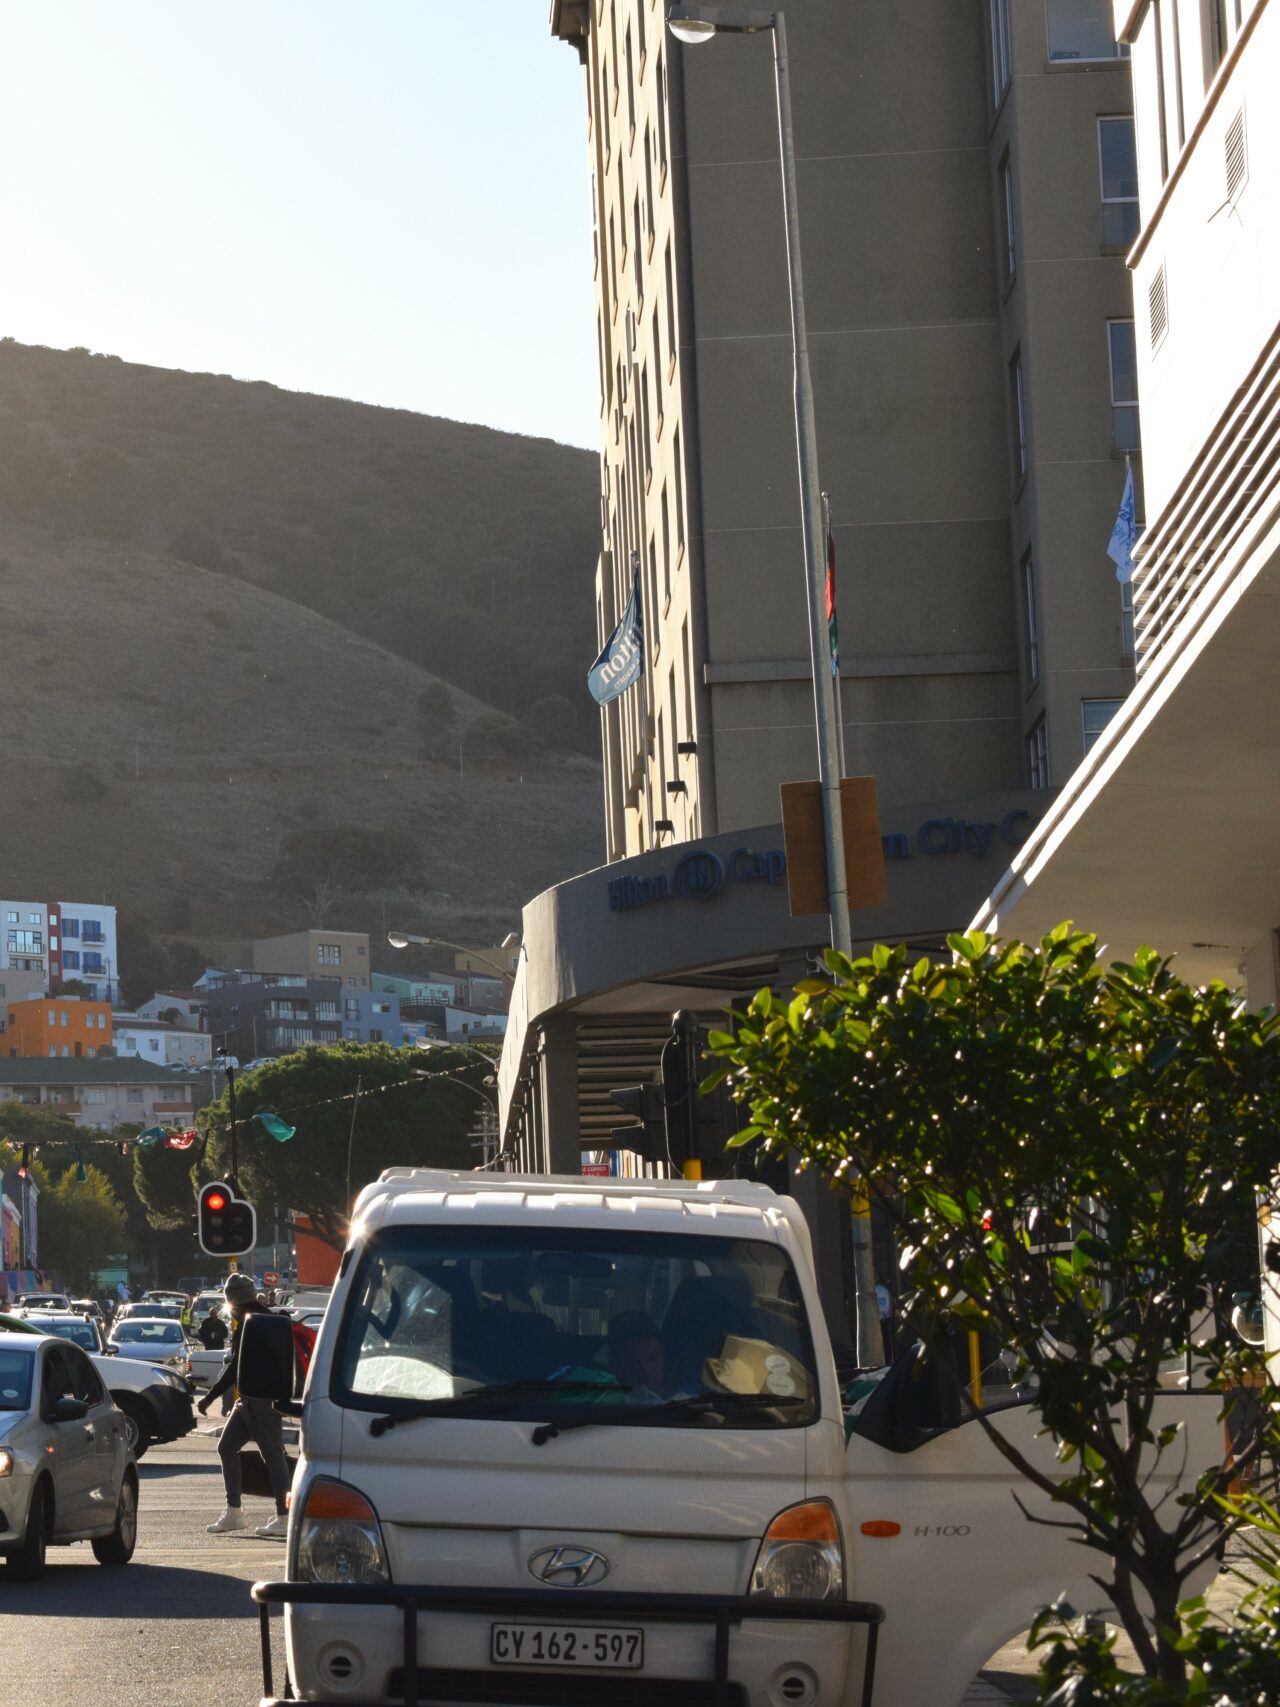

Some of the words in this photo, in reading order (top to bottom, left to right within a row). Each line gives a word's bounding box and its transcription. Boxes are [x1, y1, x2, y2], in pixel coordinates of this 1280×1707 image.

[608, 873, 669, 912] Hilton
[728, 848, 786, 885] Cap
[917, 817, 996, 858] City
[495, 1629, 524, 1658] CY
[531, 1631, 640, 1663] 162-597
